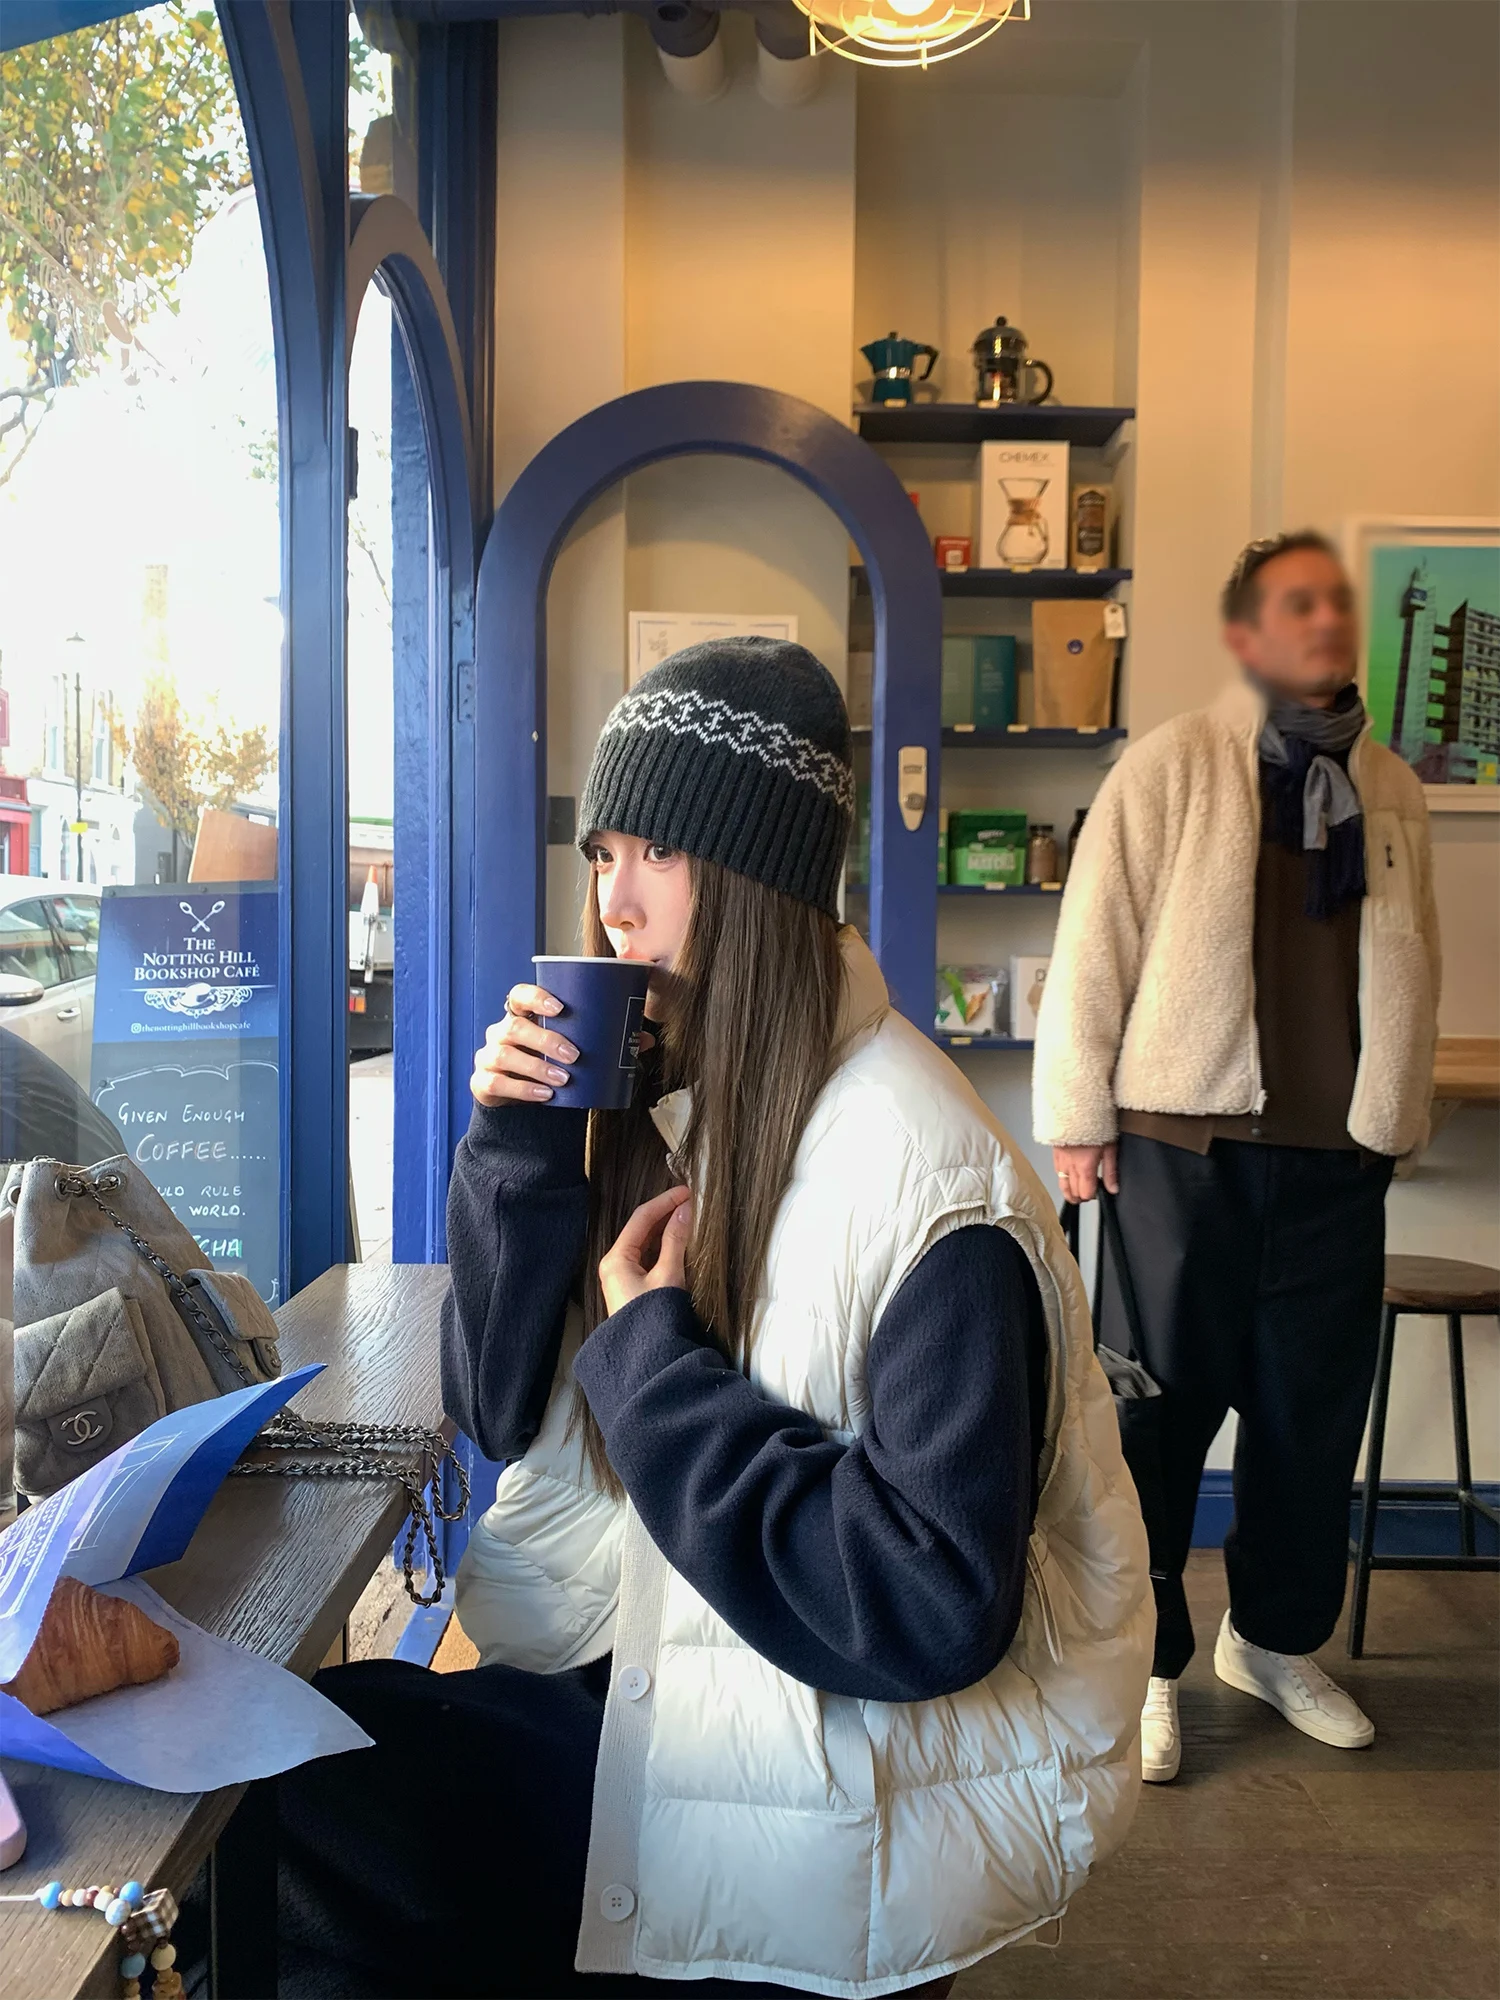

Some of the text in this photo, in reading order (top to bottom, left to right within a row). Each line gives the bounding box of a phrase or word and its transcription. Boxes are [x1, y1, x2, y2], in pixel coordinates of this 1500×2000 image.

[183, 937, 216, 951] THE
[143, 950, 256, 967] NOTTING HILL
[134, 964, 261, 981] BOOKSHOP CAFÉ
[118, 1102, 245, 1125] GIVEN ENOUGH
[157, 1185, 242, 1198] ULD RULE
[188, 1204, 246, 1218] WORLD.
[193, 1235, 243, 1258] CHA
